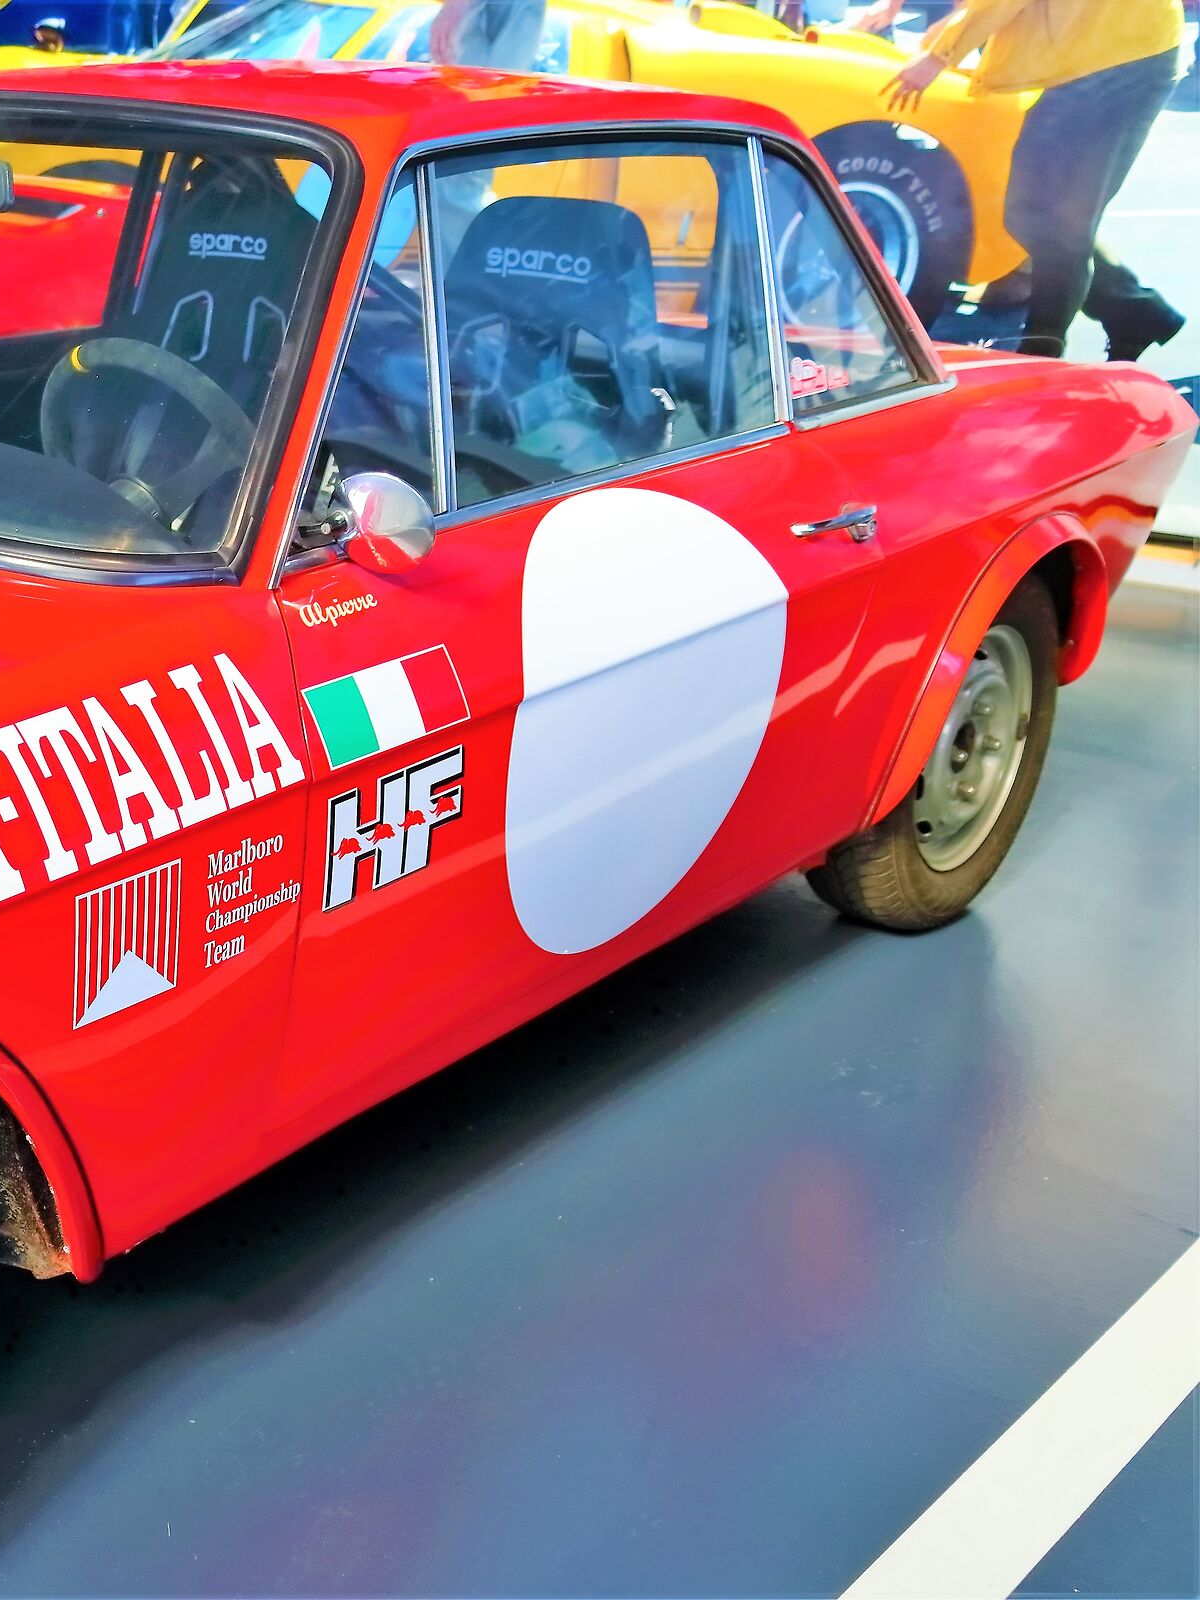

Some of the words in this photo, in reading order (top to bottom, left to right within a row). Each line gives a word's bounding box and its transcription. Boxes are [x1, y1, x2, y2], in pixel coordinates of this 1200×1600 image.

[189, 232, 268, 259] sparco
[485, 246, 592, 280] sparco
[299, 593, 378, 628] Alpierre
[321, 743, 464, 913] HF
[206, 833, 284, 879] Marlboro
[204, 878, 301, 934] Championship
[206, 866, 253, 909] World
[203, 934, 246, 969] Team
